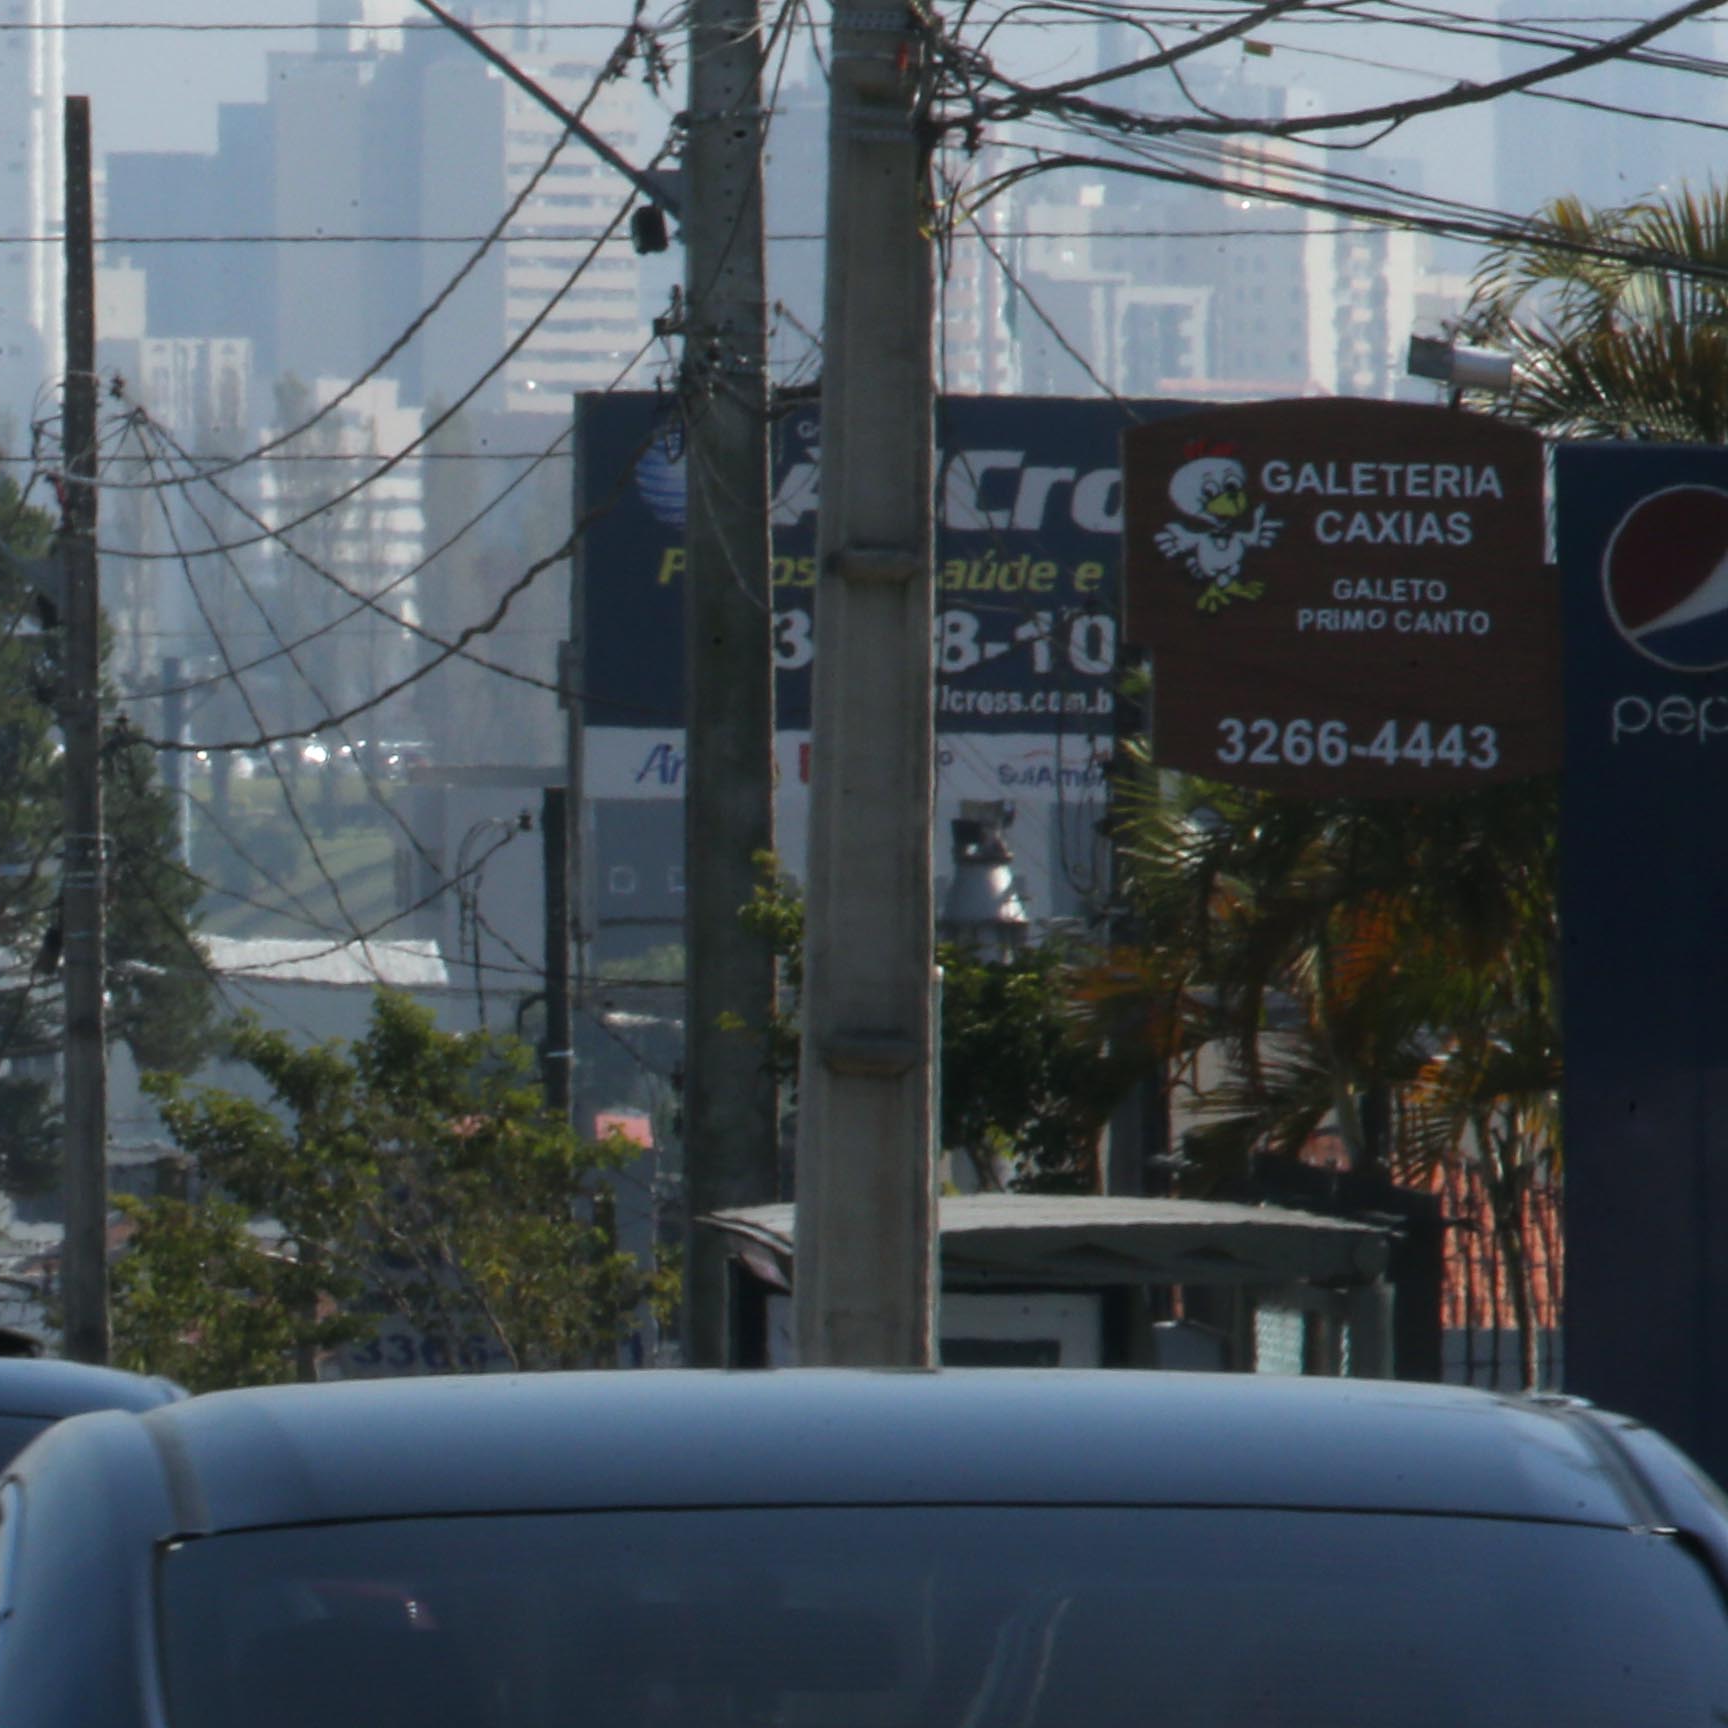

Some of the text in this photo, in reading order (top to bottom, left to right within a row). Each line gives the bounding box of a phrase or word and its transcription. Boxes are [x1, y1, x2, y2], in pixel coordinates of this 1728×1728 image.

[1261, 460, 1504, 500] GALETERIA
[1314, 510, 1473, 546] CAXIAS
[934, 550, 1058, 593] aúde
[1332, 577, 1447, 602] GALETO
[1297, 608, 1491, 635] PRIMO CANTO
[1216, 717, 1500, 770] 3266-4443
